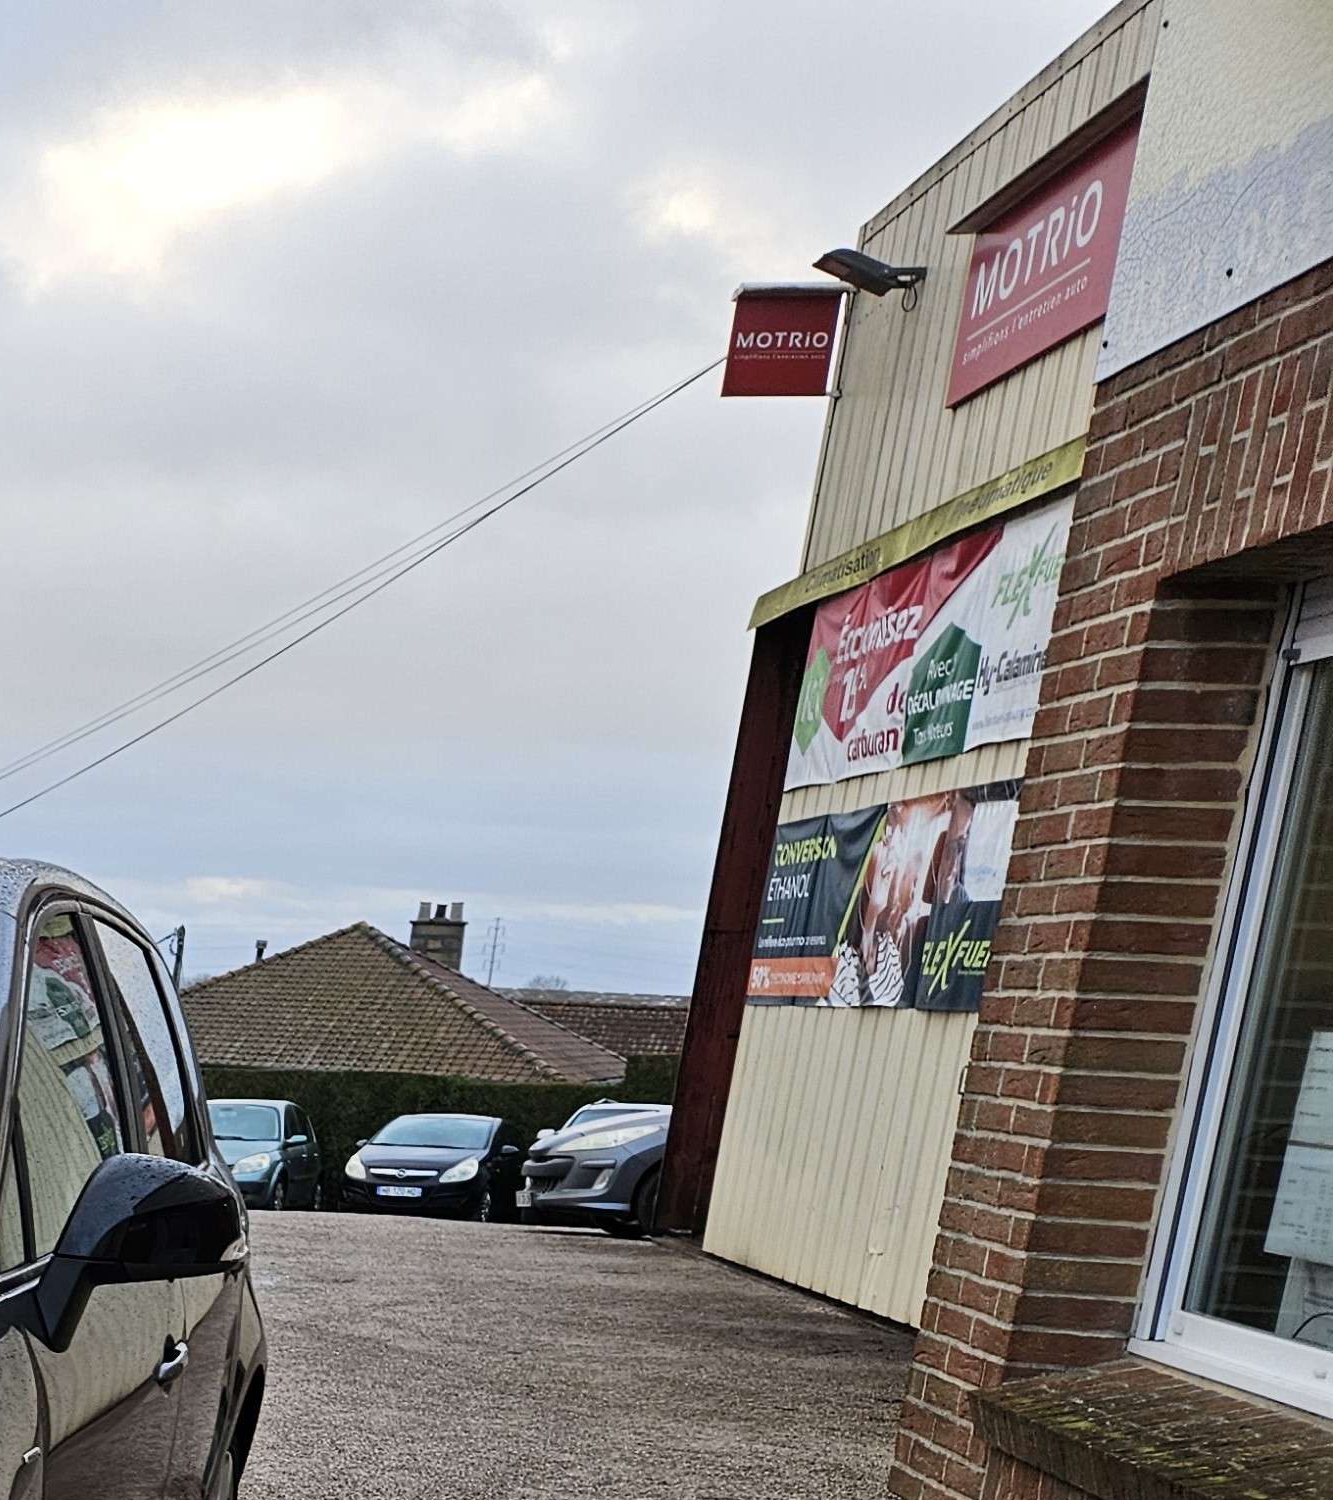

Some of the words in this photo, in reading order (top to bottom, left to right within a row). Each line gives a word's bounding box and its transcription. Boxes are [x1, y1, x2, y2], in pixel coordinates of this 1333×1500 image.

[962, 326, 1009, 365] simplifions
[1065, 276, 1088, 300] auto
[847, 727, 904, 762] carburan
[767, 871, 811, 902] ÉTHANOL
